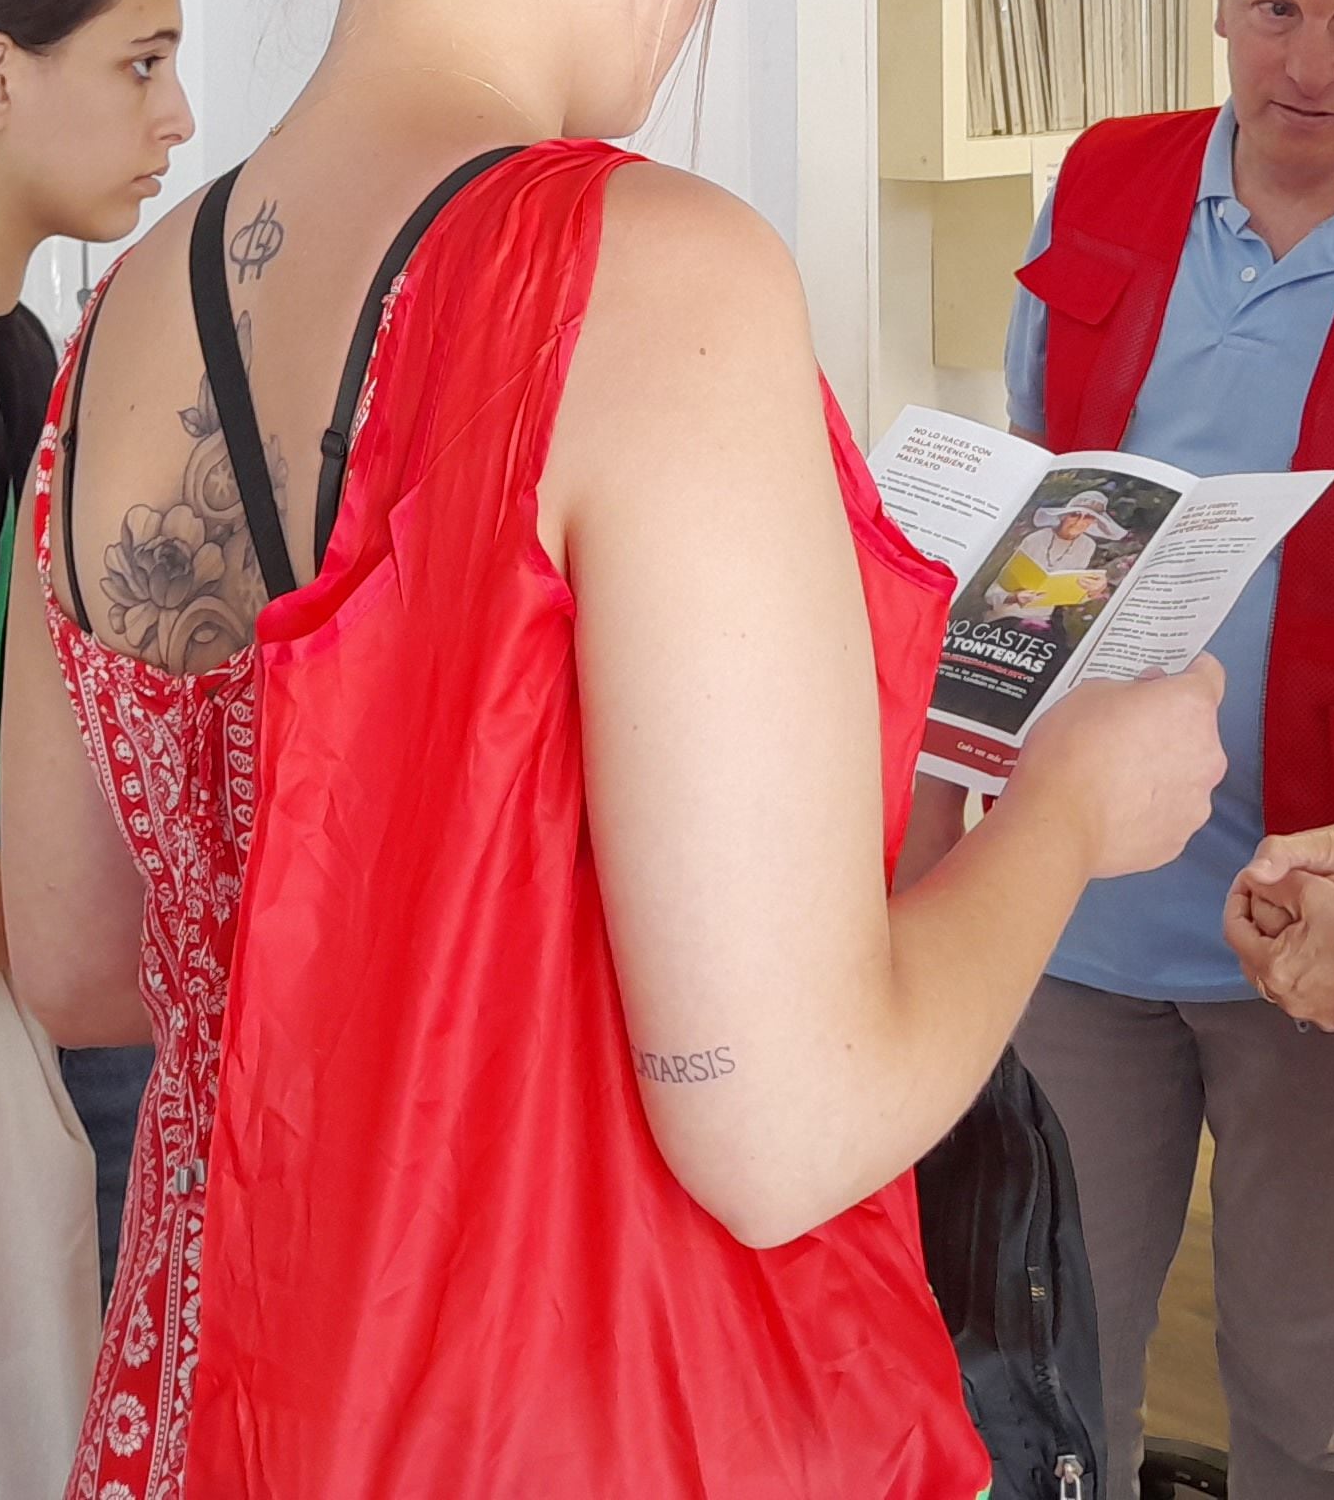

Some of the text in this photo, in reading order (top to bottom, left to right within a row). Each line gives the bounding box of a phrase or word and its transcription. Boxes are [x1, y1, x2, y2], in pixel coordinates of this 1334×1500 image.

[907, 435, 932, 448] MALA
[913, 426, 993, 457] NO LO HACES CON
[895, 452, 941, 471] MALTRATO
[901, 444, 977, 474] PERO TAMBIÉN ES
[952, 636, 1046, 674] TONTERÍAS
[972, 623, 1057, 661] GASTES
[631, 1044, 736, 1084] ATARSIS
